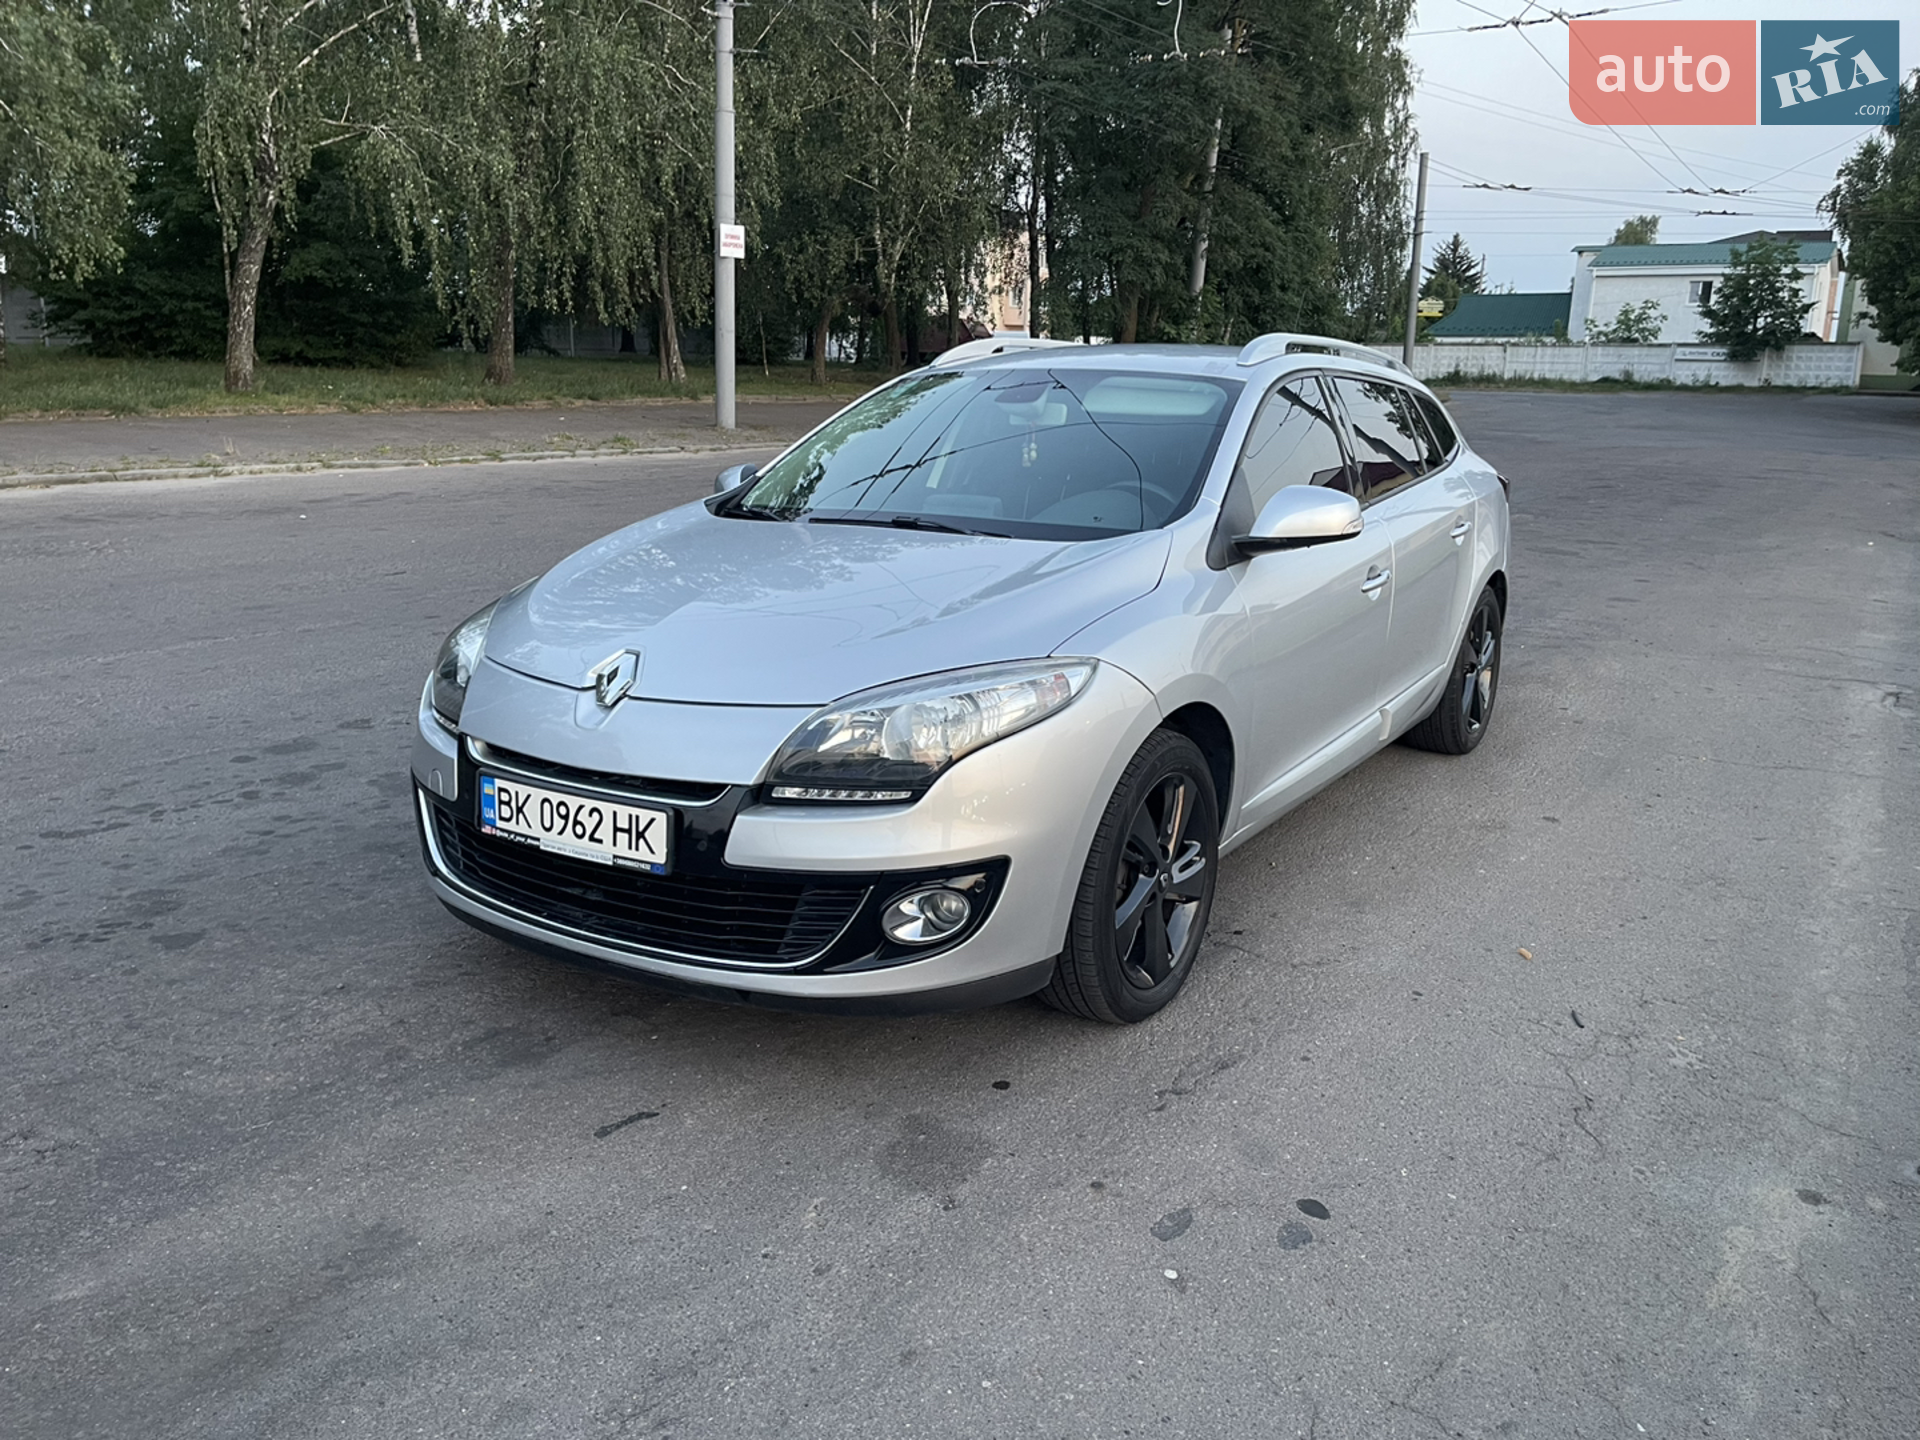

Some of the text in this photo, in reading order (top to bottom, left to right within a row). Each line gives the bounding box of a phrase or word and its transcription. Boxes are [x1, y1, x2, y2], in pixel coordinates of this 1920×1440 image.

[484, 807, 496, 820] UA
[497, 786, 532, 829] BK
[540, 797, 604, 845] 0962
[612, 810, 657, 856] HK
